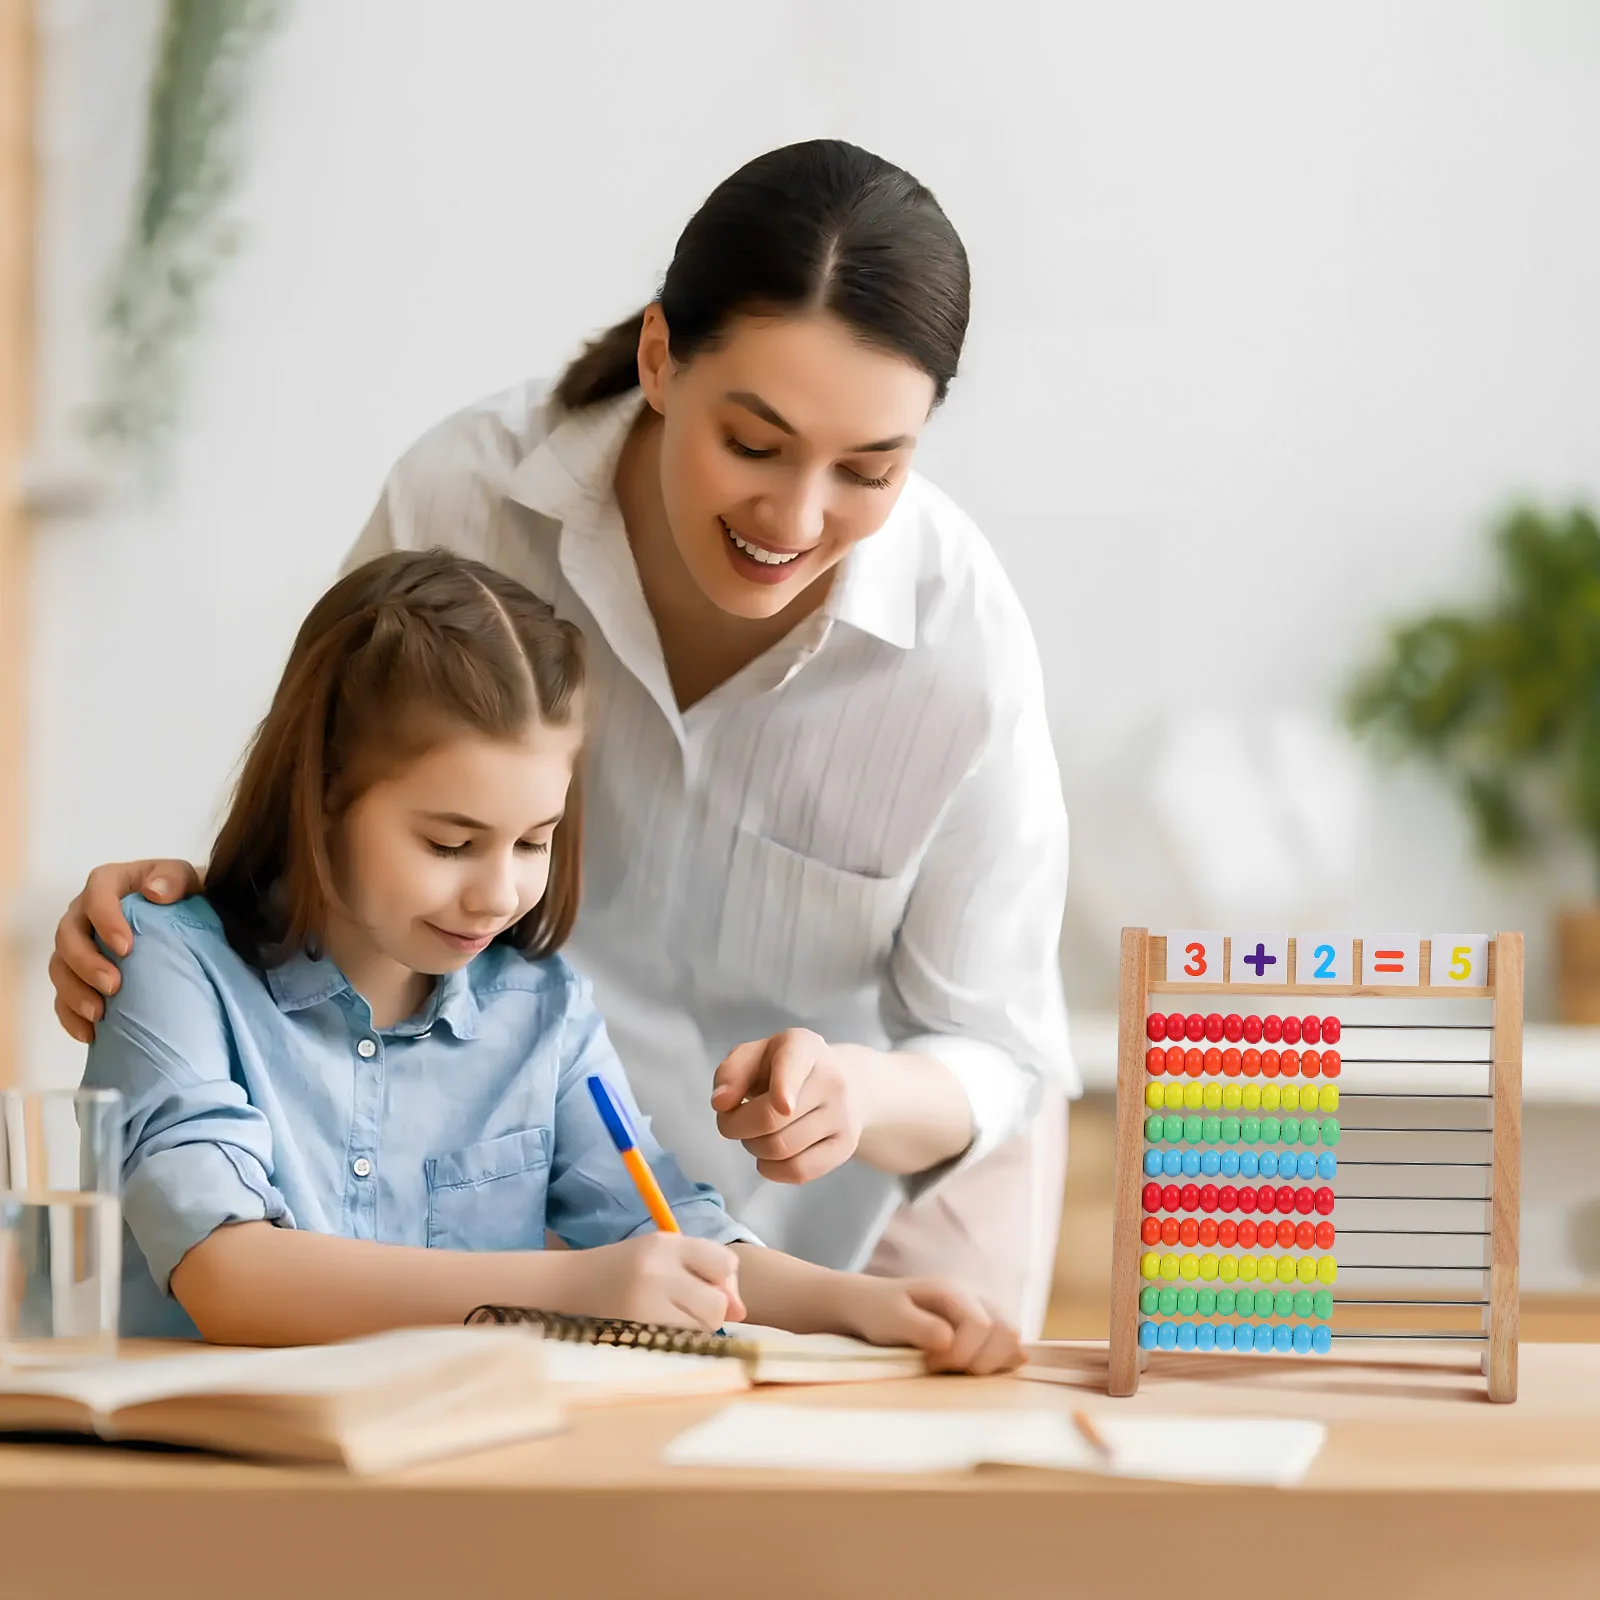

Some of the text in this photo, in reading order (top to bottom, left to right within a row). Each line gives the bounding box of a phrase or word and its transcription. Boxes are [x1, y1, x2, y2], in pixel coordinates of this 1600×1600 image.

[1183, 942, 1473, 980] 3 + 2 = 5
